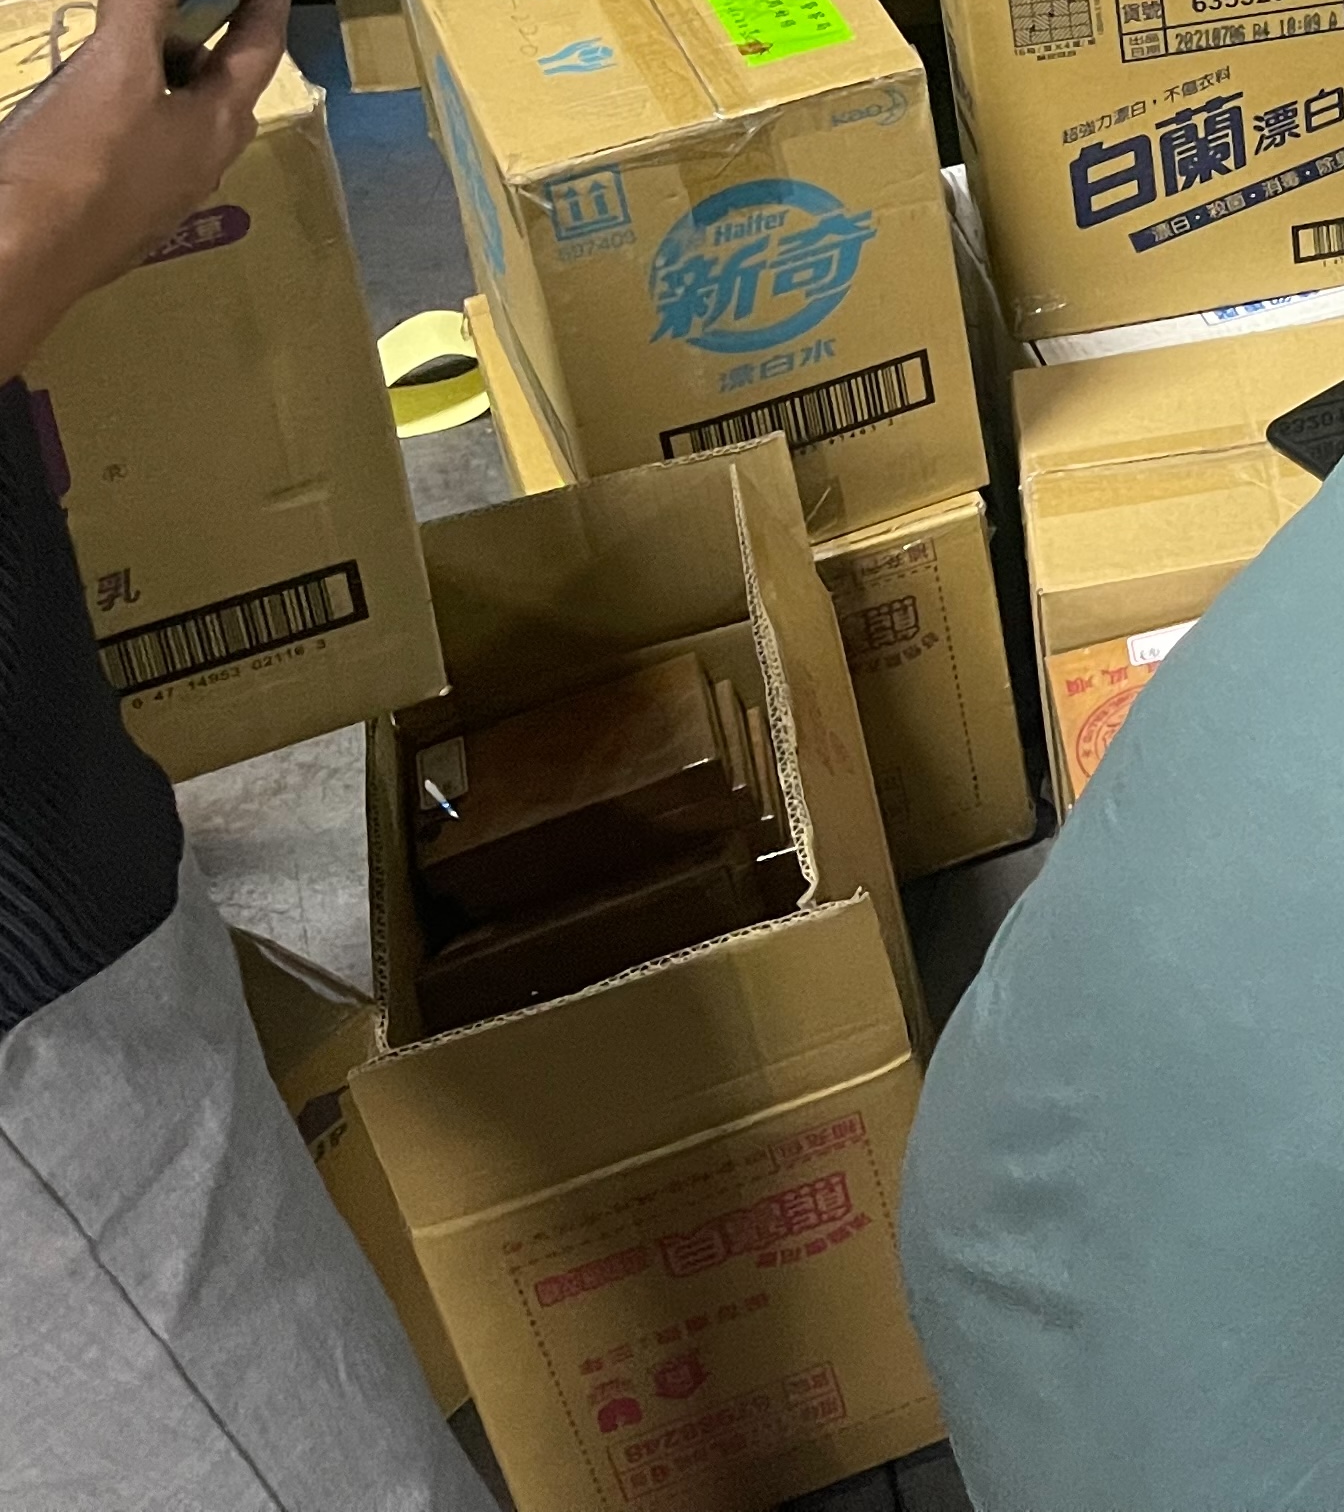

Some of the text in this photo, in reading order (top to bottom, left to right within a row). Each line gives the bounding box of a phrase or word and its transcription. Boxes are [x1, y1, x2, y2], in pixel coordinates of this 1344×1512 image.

[1069, 91, 1248, 230] 白蘭
[719, 336, 837, 394] 漂白水
